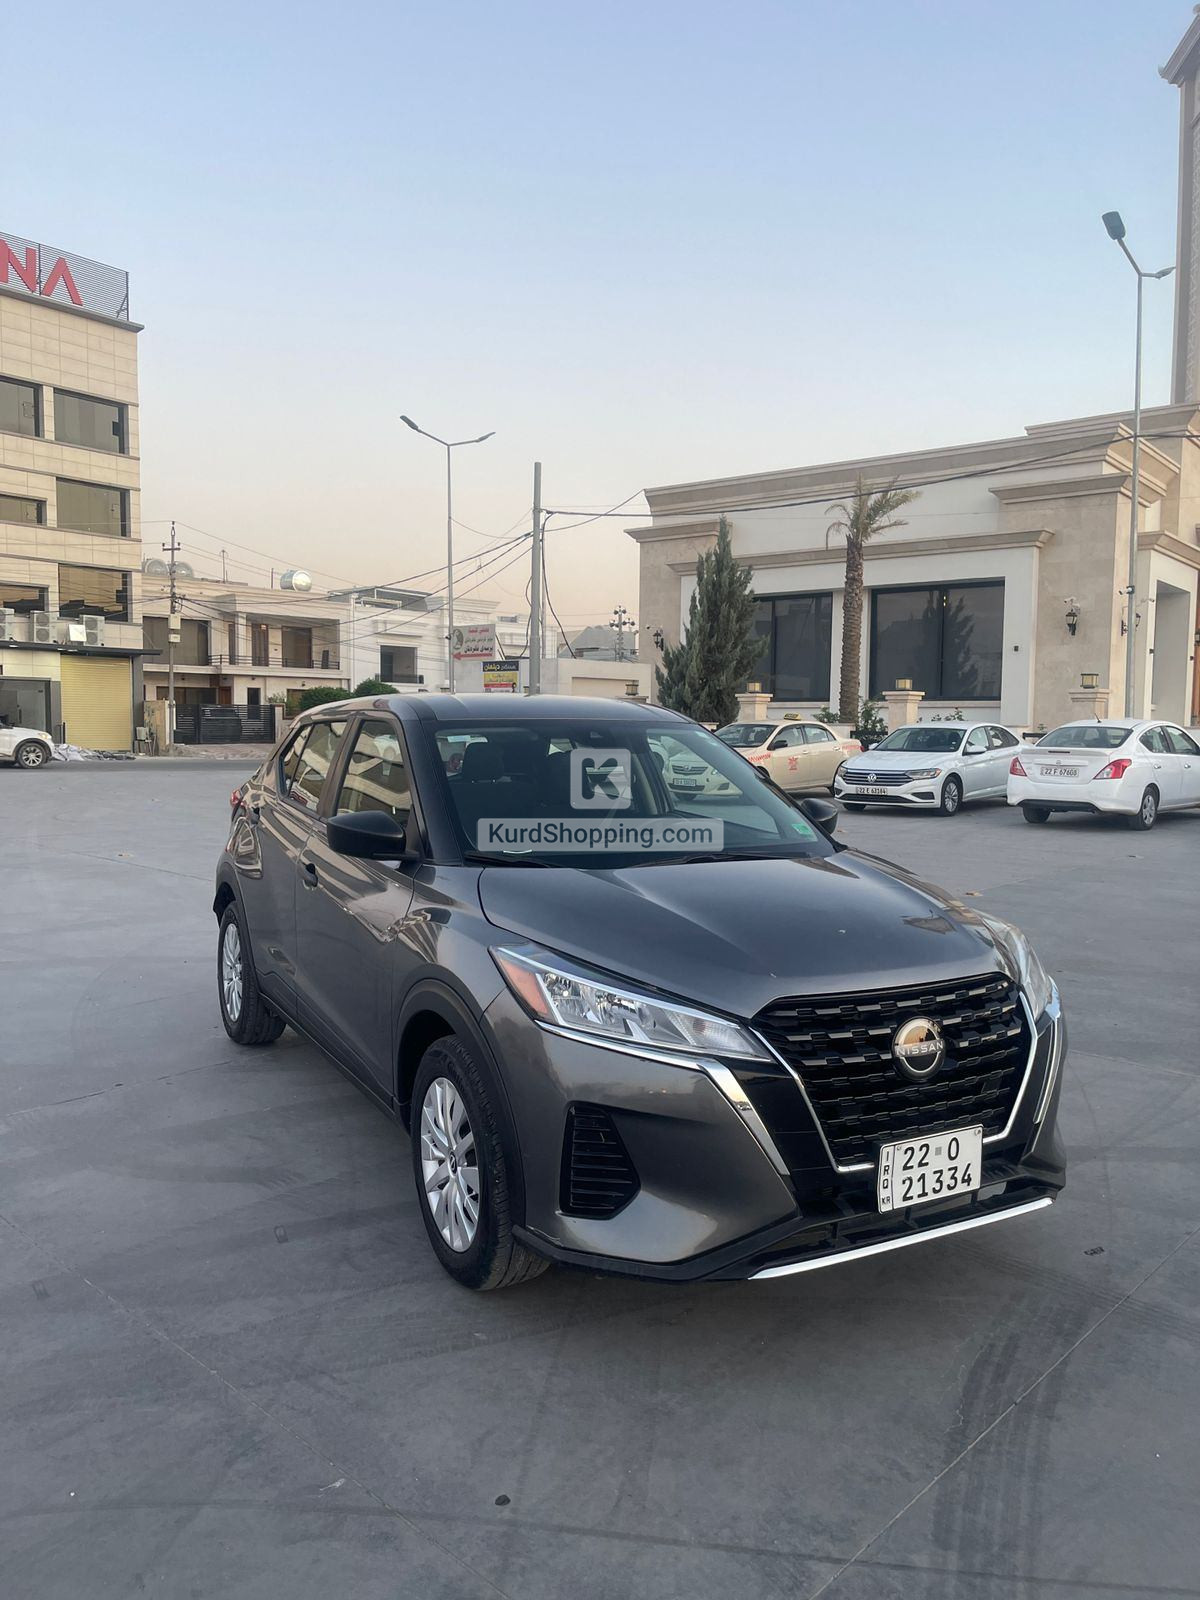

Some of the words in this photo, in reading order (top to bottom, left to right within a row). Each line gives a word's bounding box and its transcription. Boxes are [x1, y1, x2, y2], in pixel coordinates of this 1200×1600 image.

[896, 1040, 944, 1057] NISSAN
[902, 1143, 930, 1171] 22
[902, 1163, 972, 1202] 21334
[881, 1196, 891, 1205] KR
